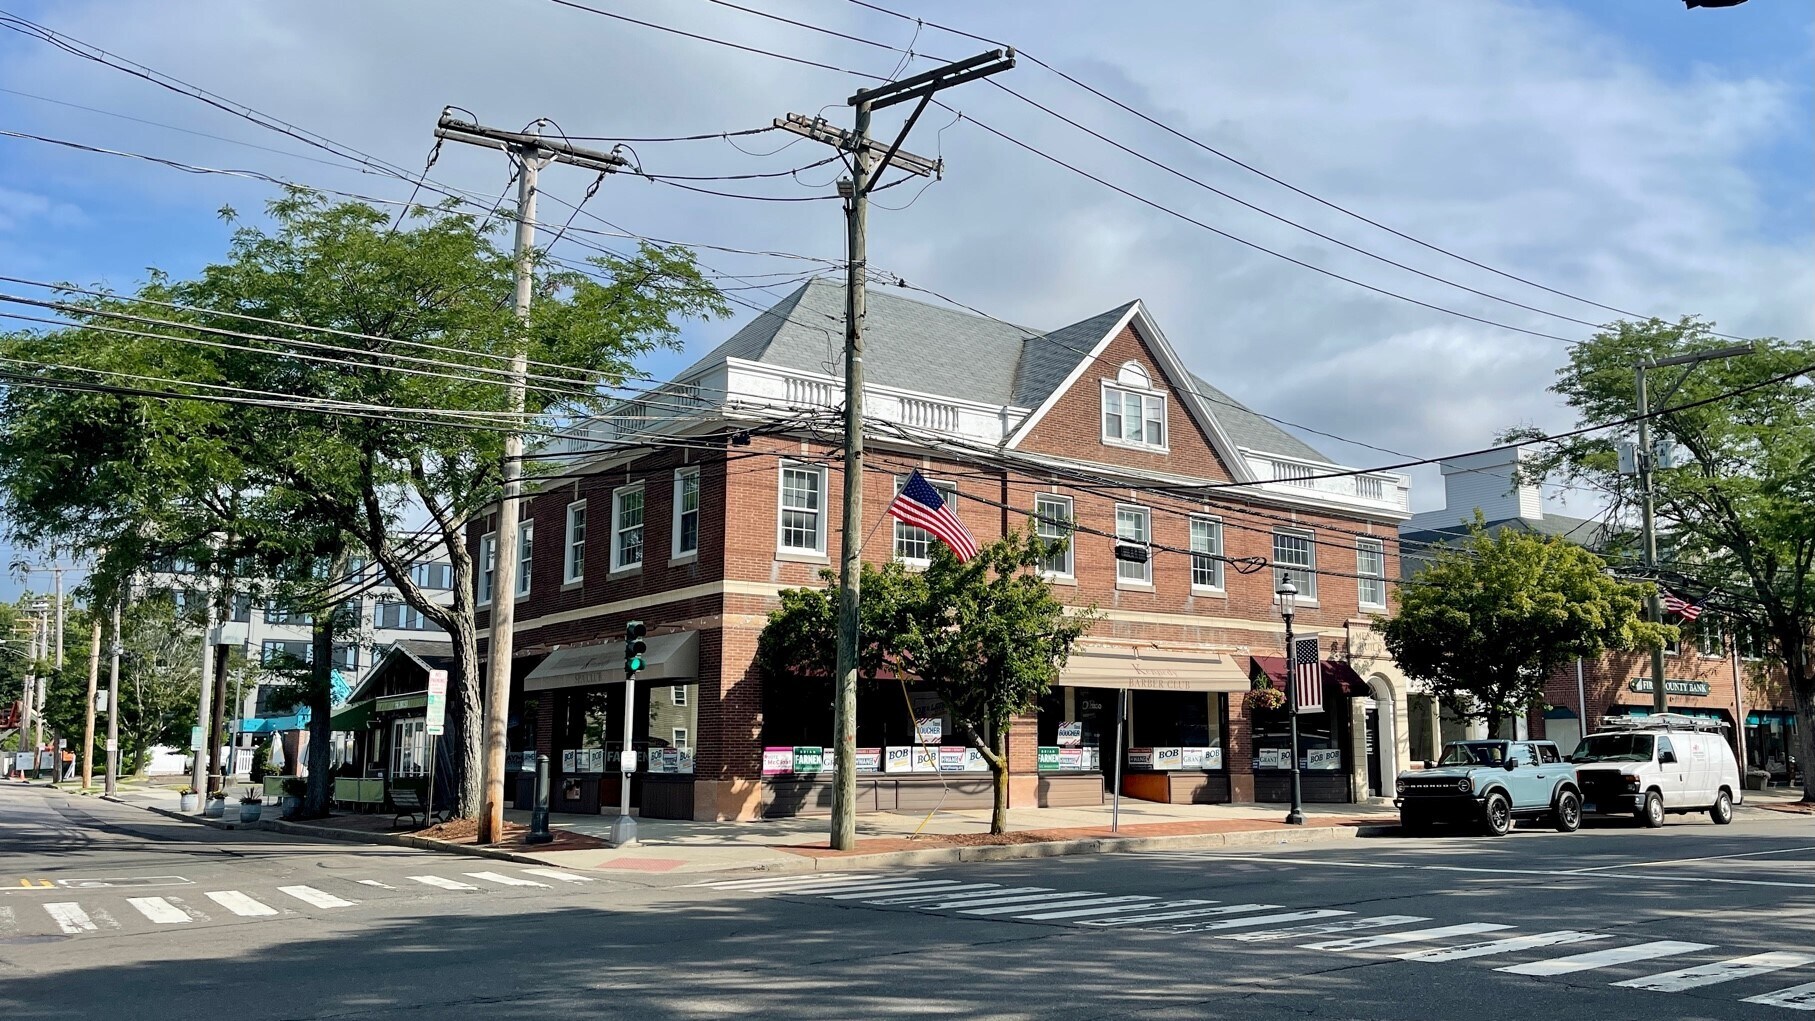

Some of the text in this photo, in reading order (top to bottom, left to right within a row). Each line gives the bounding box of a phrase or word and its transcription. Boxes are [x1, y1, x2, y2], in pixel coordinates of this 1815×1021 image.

[1128, 677, 1190, 690] BARBER CLUB
[1665, 682, 1688, 692] OUNTY
[1689, 683, 1707, 693] BANK
[564, 750, 574, 762] BOB
[591, 750, 602, 761] BOB
[651, 749, 662, 761] BOB
[889, 748, 909, 760] BOB
[917, 752, 937, 764] BOB
[969, 751, 984, 761] BO
[1159, 749, 1179, 759] BOB
[1205, 748, 1221, 759] BOB
[1281, 751, 1291, 760] BO
[1310, 753, 1323, 764] BOB
[1326, 750, 1340, 760] BOB
